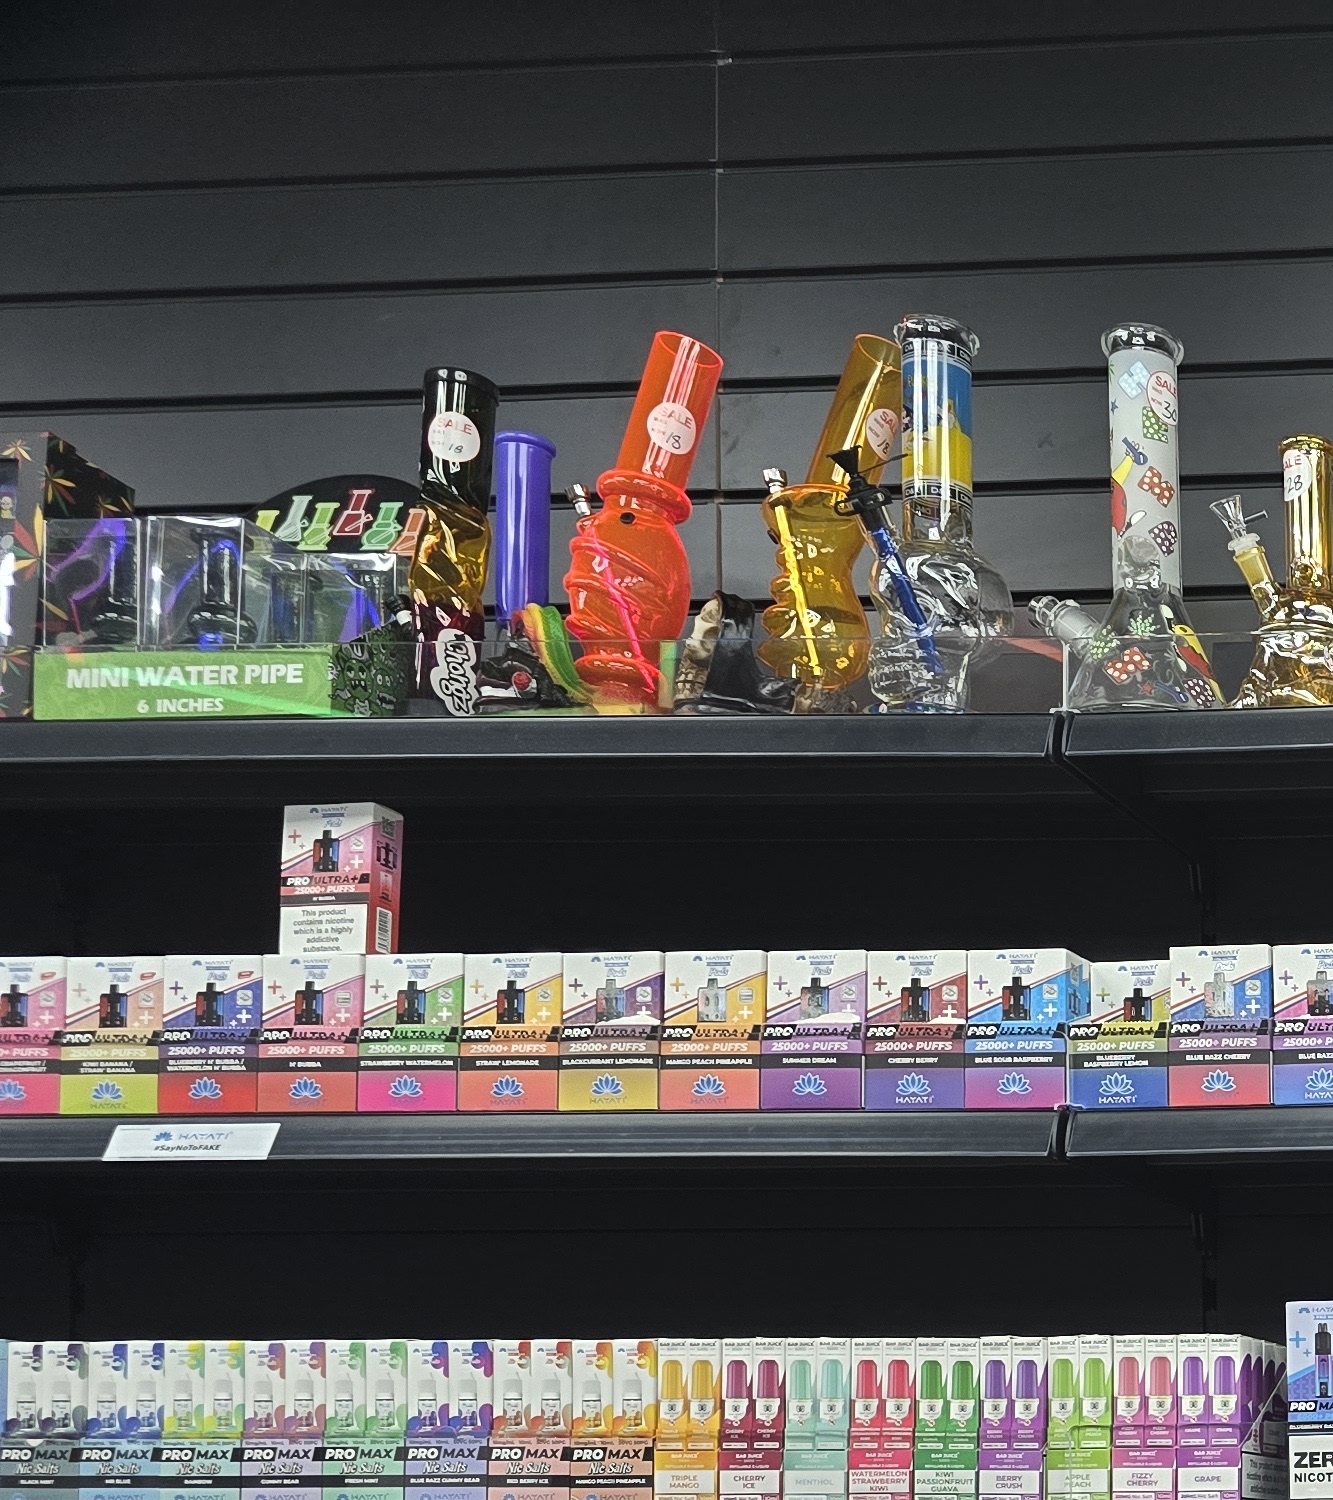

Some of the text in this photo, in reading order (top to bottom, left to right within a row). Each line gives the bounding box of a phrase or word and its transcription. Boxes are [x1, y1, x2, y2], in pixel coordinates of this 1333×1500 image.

[67, 664, 303, 689] MINI WATER PIPE
[137, 698, 224, 713] 6 INCHES
[318, 909, 346, 917] product
[294, 927, 314, 935] which
[331, 926, 353, 934] highly
[179, 1131, 230, 1141] HAYATI
[154, 1143, 221, 1152] #SayNoToFAKE
[244, 1448, 311, 1460] PRO MAX
[260, 1462, 310, 1475] Nic Salts
[670, 1474, 698, 1482] TRIPLE
[851, 1477, 909, 1485] STRAWBERRY
[1194, 1475, 1222, 1483] GRAPE
[669, 1482, 700, 1490] MANGO
